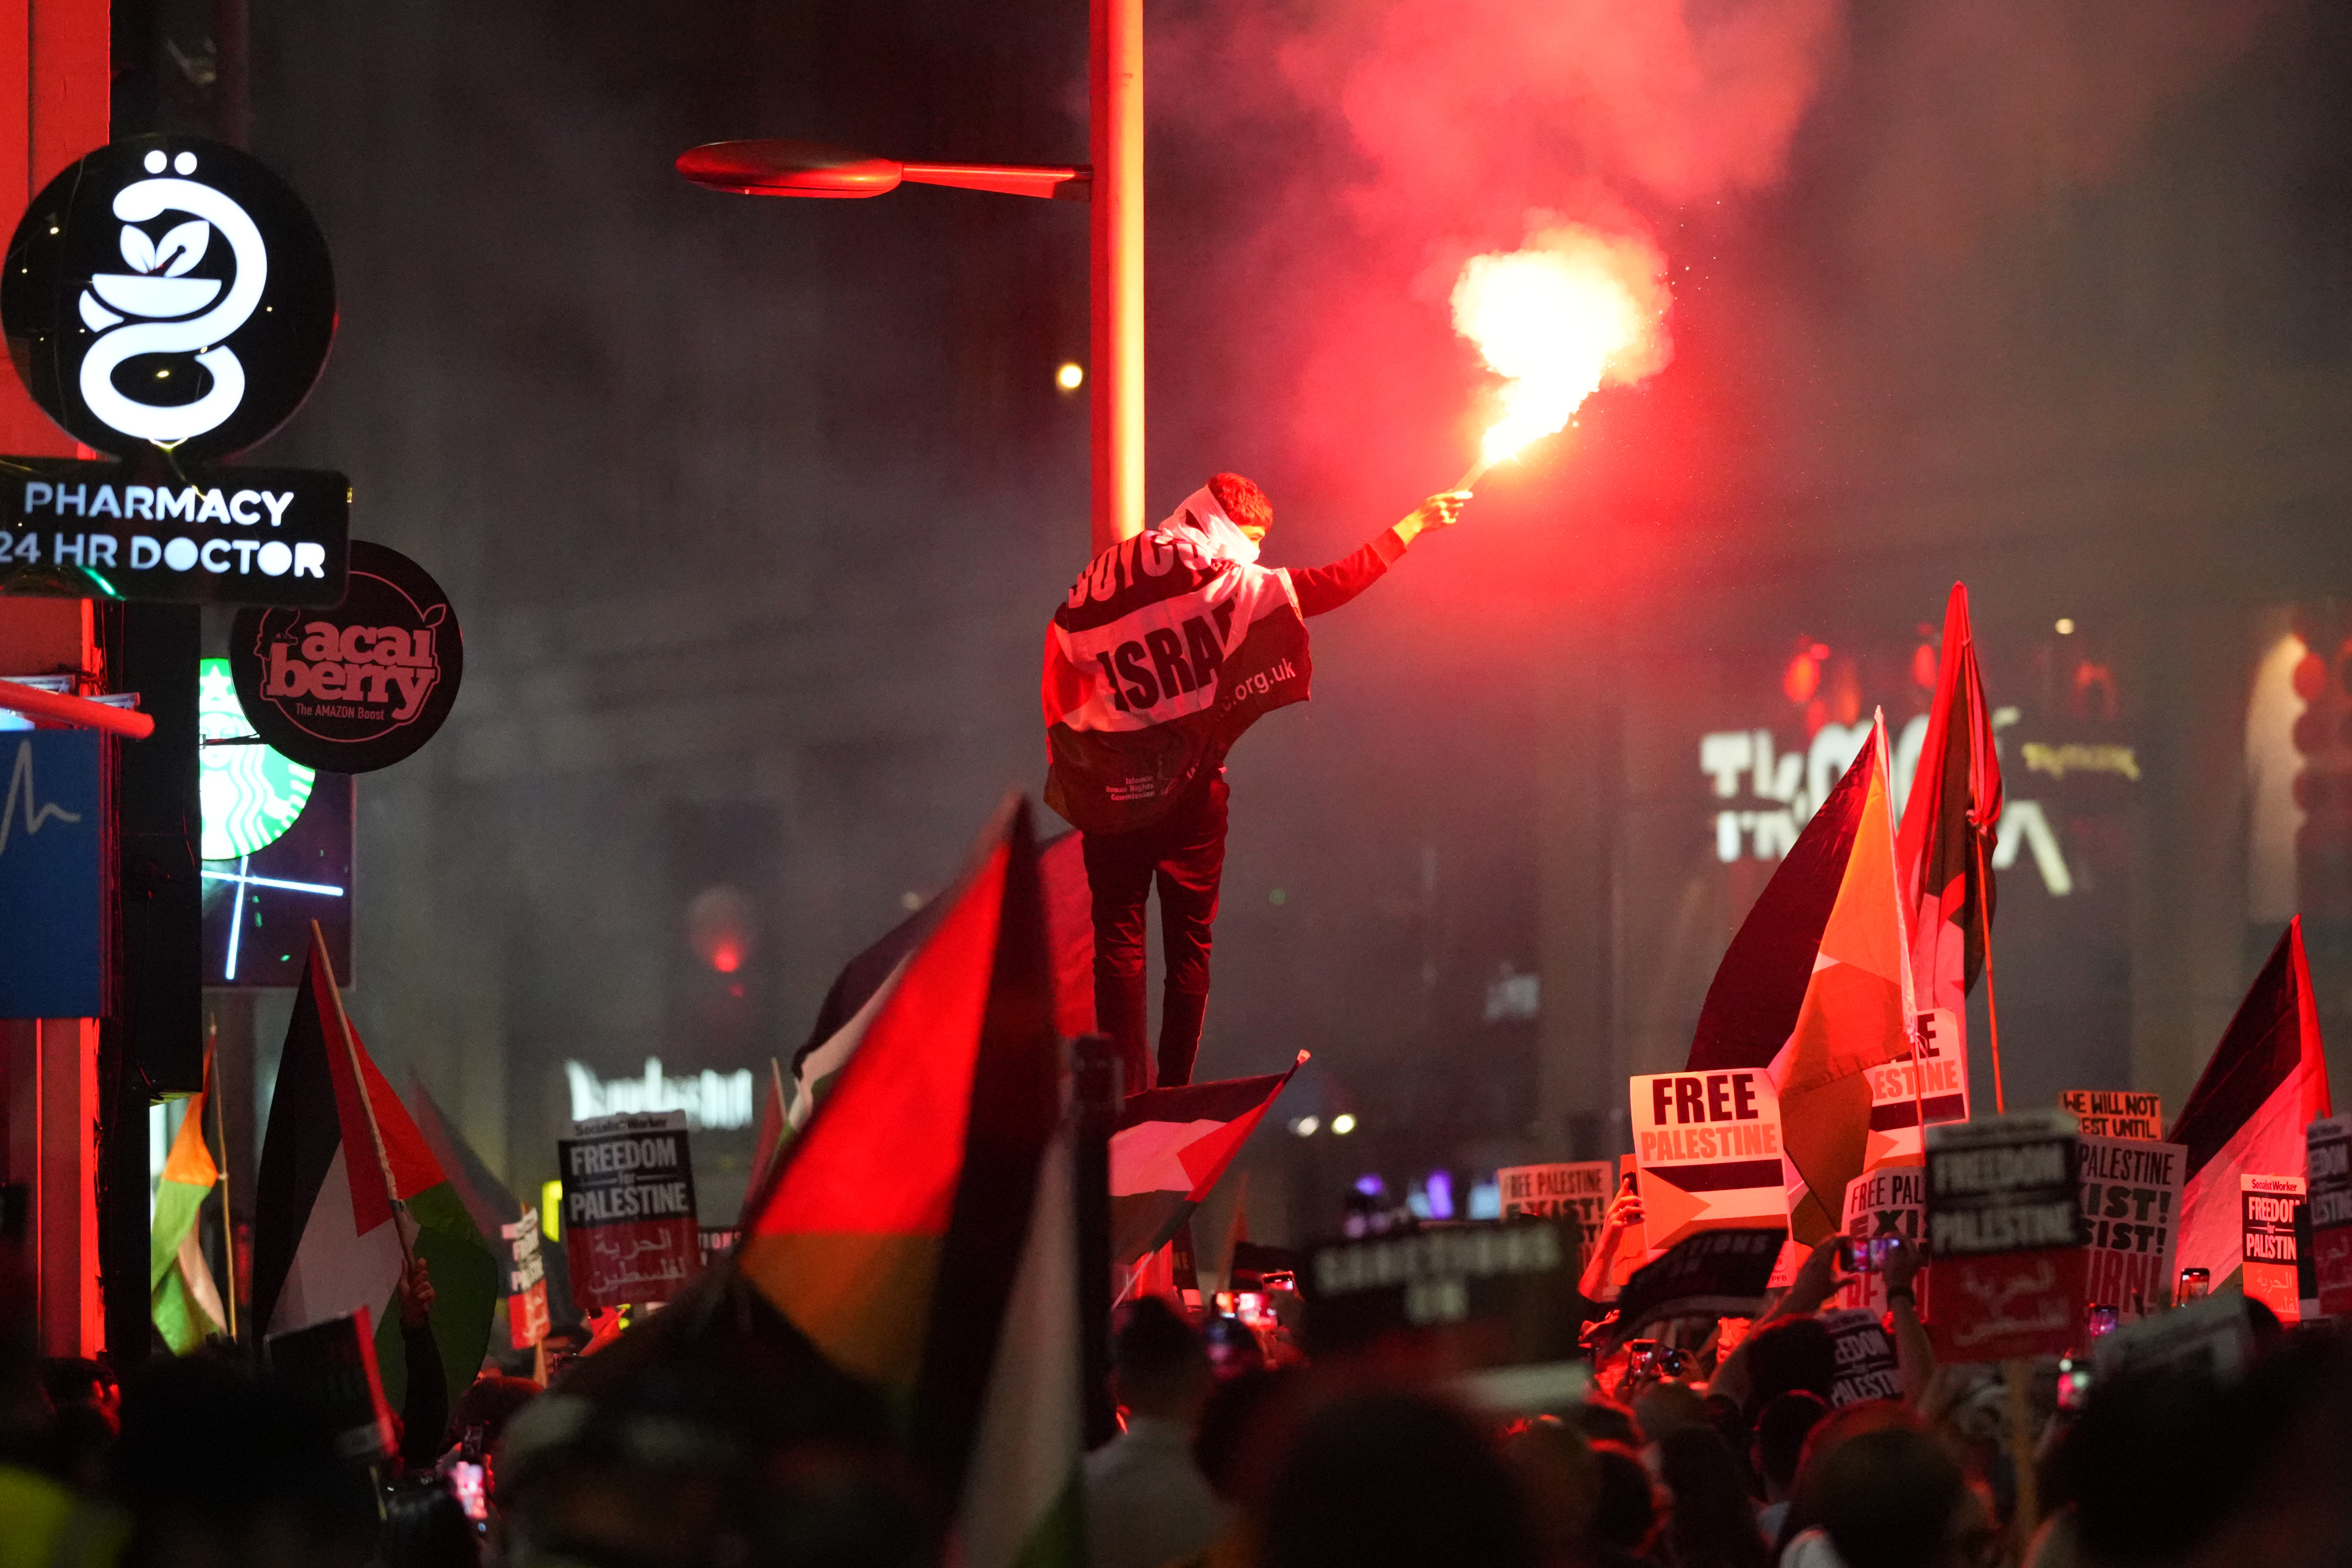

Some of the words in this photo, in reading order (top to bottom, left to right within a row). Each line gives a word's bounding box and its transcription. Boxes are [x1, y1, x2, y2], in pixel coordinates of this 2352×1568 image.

[25, 482, 294, 526] PHARMACY
[54, 532, 119, 568] HR
[130, 535, 325, 578] DOCTOR
[267, 642, 436, 720] berry
[295, 703, 312, 715] The
[315, 705, 355, 718] AMAZON
[358, 707, 385, 720] Boost
[1111, 791, 1155, 801] Commission
[1125, 776, 1154, 785] Islamic
[1129, 783, 1154, 792] Rights
[1653, 1073, 1759, 1126] FREE
[2063, 1093, 2086, 1114] WE
[2090, 1094, 2123, 1116] WILL
[2125, 1095, 2159, 1117] NOT
[1641, 1123, 1778, 1161] PALESTINE
[2081, 1118, 2109, 1136] EST
[2112, 1120, 2157, 1138] UNTIL
[570, 1137, 678, 1176] FREEDOM
[2078, 1143, 2174, 1185] PALESTINE
[570, 1182, 688, 1222] PALESTINE
[1850, 1176, 1885, 1214] FREE
[2085, 1182, 2172, 1224] IST!
[2273, 1180, 2297, 1191] Worker
[2267, 1222, 2275, 1234] for
